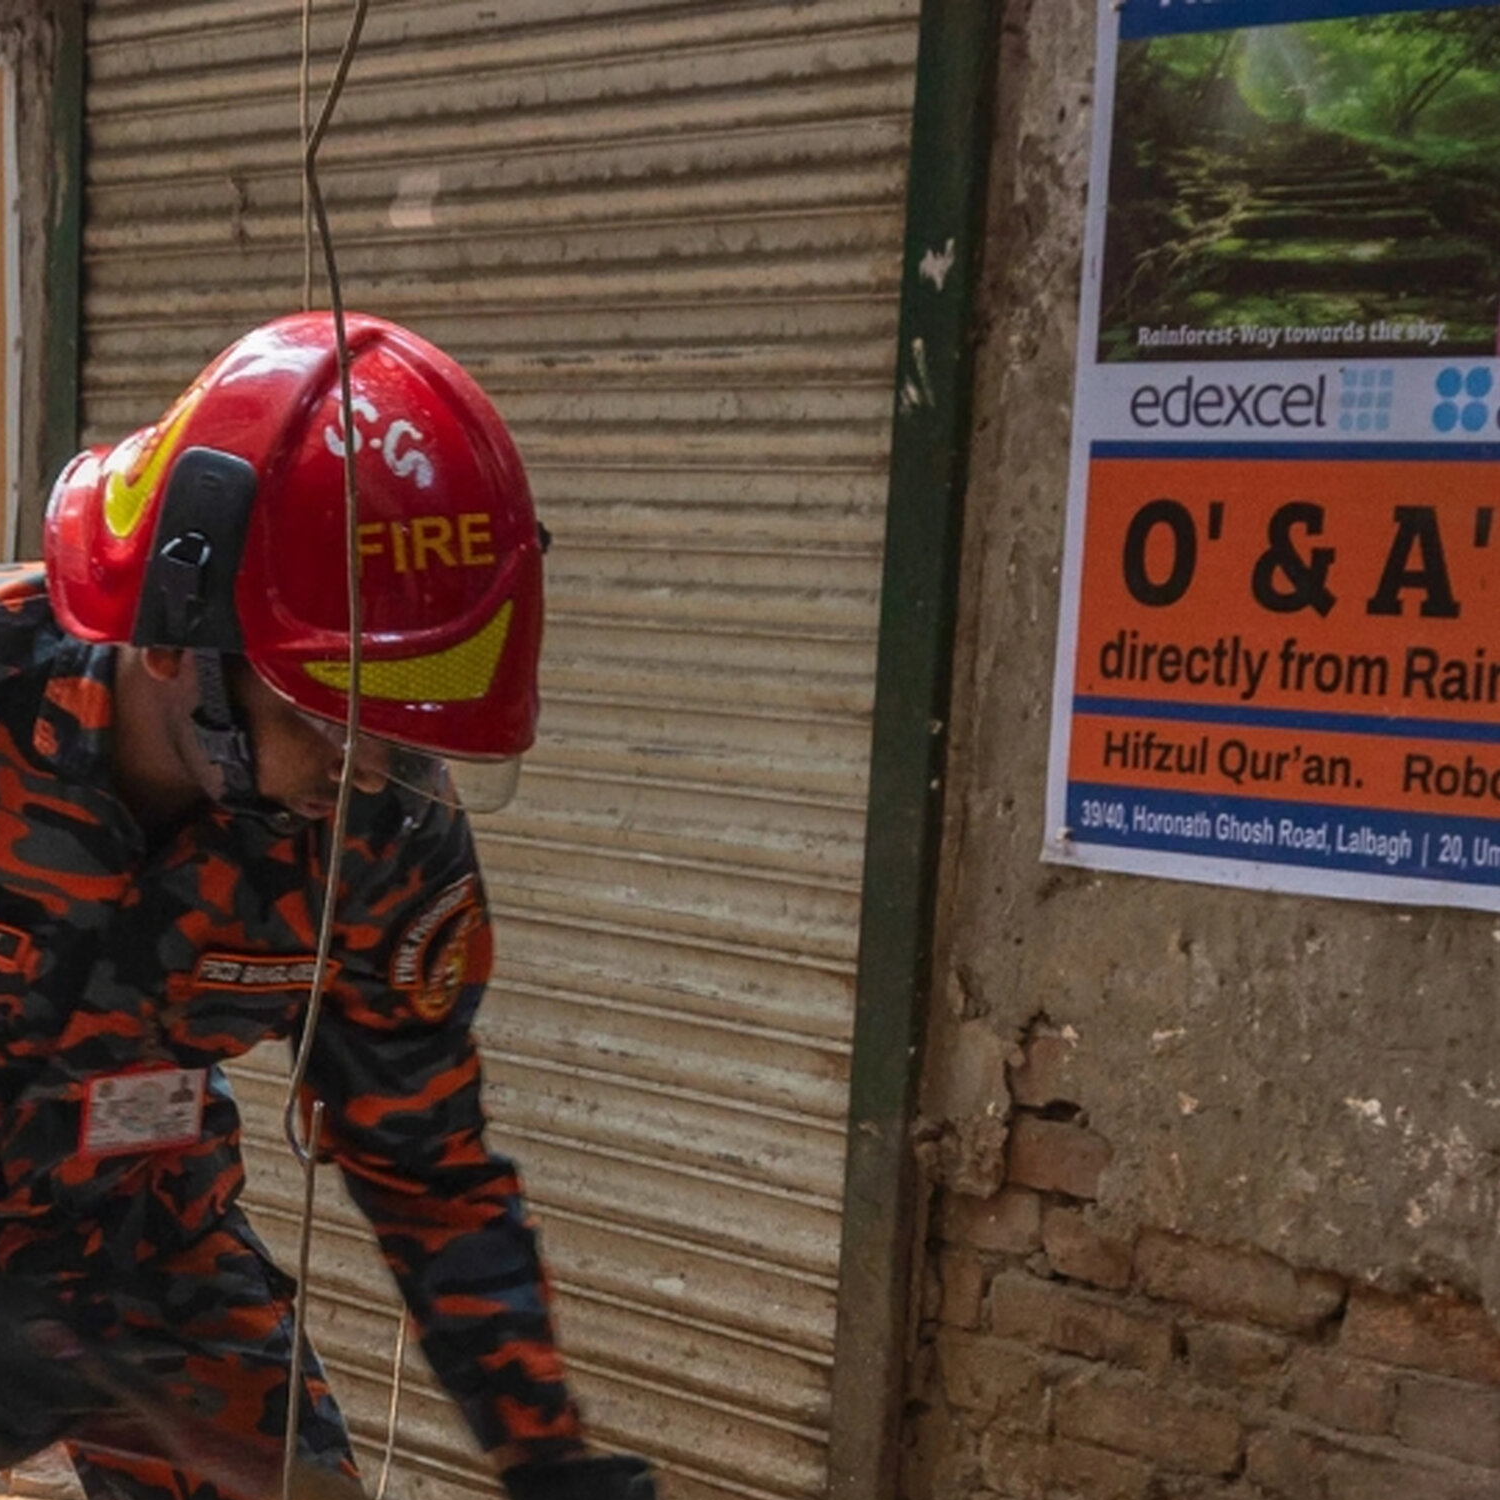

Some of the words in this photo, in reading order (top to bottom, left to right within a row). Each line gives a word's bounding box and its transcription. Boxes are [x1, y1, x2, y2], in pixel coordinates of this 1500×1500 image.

[1137, 323, 1280, 349] Rainforest-Way
[1284, 320, 1365, 343] towards
[1369, 319, 1400, 340] the
[1407, 318, 1448, 346] sky.
[1129, 374, 1327, 428] edexcel
[355, 512, 496, 575] FIRE
[1121, 498, 1226, 608] O'
[1250, 500, 1338, 618] &
[1365, 504, 1494, 619] A'
[1100, 630, 1269, 700] directly
[1278, 638, 1389, 697] from
[1102, 730, 1208, 776] Hifzul
[1132, 806, 1211, 840] Horonath
[1215, 812, 1274, 847] Ghosh
[1277, 818, 1332, 855] Road,
[1336, 825, 1412, 867] Lalbagh
[1438, 834, 1468, 868] 20,
